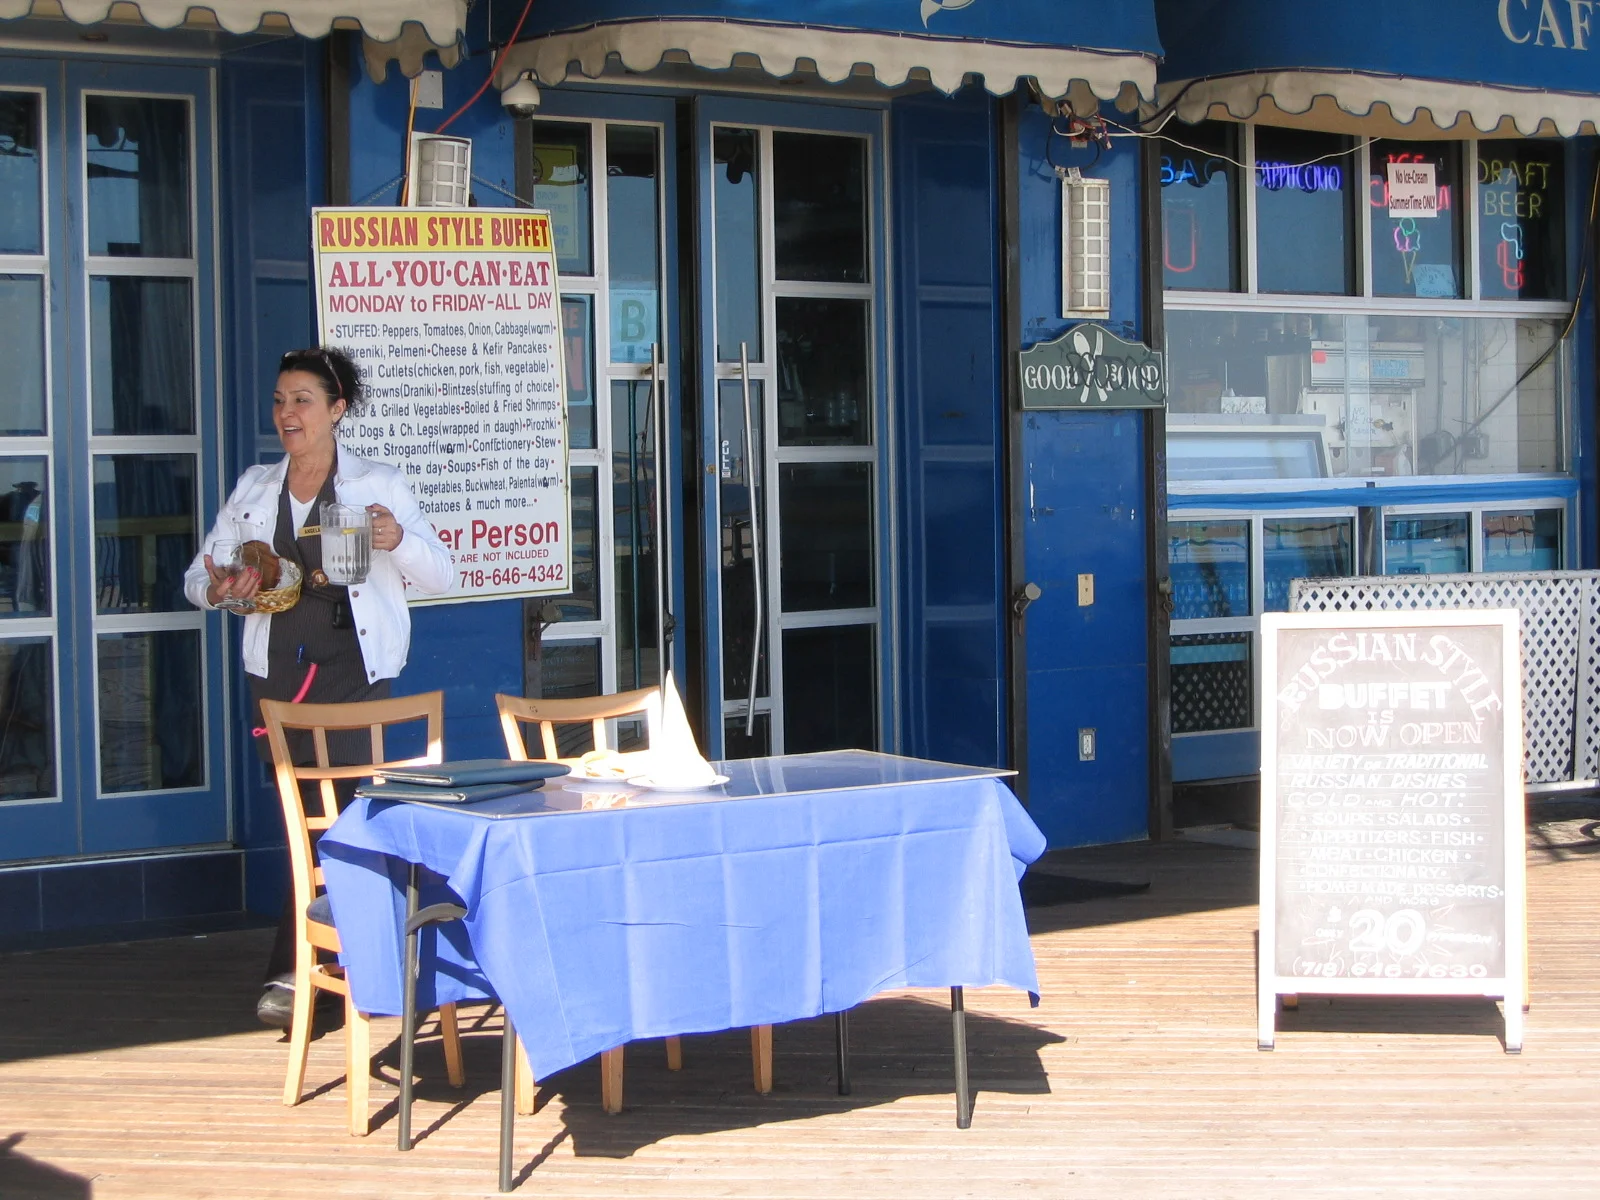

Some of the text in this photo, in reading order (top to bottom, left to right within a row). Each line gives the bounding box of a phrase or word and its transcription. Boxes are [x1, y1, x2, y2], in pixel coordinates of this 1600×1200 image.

[1395, 170, 1429, 184] No Ice-Cream
[1478, 159, 1550, 189] DRAFT
[1423, 195, 1436, 210] ONLY
[1484, 190, 1542, 218] BEER
[320, 216, 418, 247] RUSSIAN
[427, 217, 484, 247] STYLE
[491, 218, 548, 247] BUFFET
[329, 295, 405, 313] MONDAY
[410, 297, 428, 313] to
[528, 292, 552, 310] DAY
[335, 324, 380, 338] STUFFED:
[382, 324, 421, 340] Peppers,
[423, 322, 467, 338] Tomatoes,
[468, 322, 494, 338] Onion,
[621, 300, 647, 342] B
[388, 344, 426, 358] Pelmeni
[431, 343, 467, 356] Cheese
[471, 342, 478, 356] &
[482, 342, 503, 356] Kefir
[507, 341, 547, 355] Pancakes
[459, 361, 482, 378] pork,
[484, 361, 503, 376] fish,
[505, 358, 549, 376] vegetable)
[1024, 364, 1079, 391] GOOD
[514, 380, 523, 394] of
[526, 378, 556, 394] choice)
[370, 403, 377, 417] &
[381, 403, 409, 417] Grilled
[413, 401, 460, 418] Vegetables
[464, 400, 490, 414] Boiled
[493, 400, 499, 413] &
[503, 399, 523, 413] Fried
[526, 398, 556, 412] Shrimps
[338, 424, 355, 439] Hot
[359, 424, 384, 440] Dogs
[388, 423, 395, 437] &
[483, 419, 490, 433] in
[526, 417, 557, 431] Pirozhki
[535, 435, 556, 449] Stew
[722, 440, 730, 470] PULL
[406, 462, 421, 475] the
[426, 460, 442, 476] day
[447, 459, 476, 474] Soups
[480, 458, 499, 471] Fish
[503, 457, 512, 470] of
[516, 456, 530, 469] the
[534, 456, 550, 470] day
[419, 479, 464, 497] Vegetables,
[465, 477, 507, 493] Buckwheat,
[419, 500, 461, 514] Potatoes
[465, 498, 472, 511] &
[476, 497, 501, 511] much
[431, 519, 559, 551] er Person
[460, 553, 478, 563] ARE
[482, 552, 502, 562] NOT
[505, 549, 549, 560] INCLUDED
[460, 563, 563, 588] 718-646-4342
[1278, 632, 1501, 720] RUSSIAN STYLE
[1318, 681, 1453, 710] BUFFET
[1367, 709, 1394, 724] IS
[1305, 721, 1484, 750] NOW OPEN
[1385, 753, 1489, 769] TRADITIONAL
[1290, 772, 1468, 788] RUSSIAN DISHES
[1287, 792, 1362, 807] COLD
[1311, 812, 1462, 827] SOUPS SALADS
[1431, 831, 1475, 845] FISH
[1348, 908, 1427, 956] 20
[1292, 956, 1488, 978] (718) 646-7630
